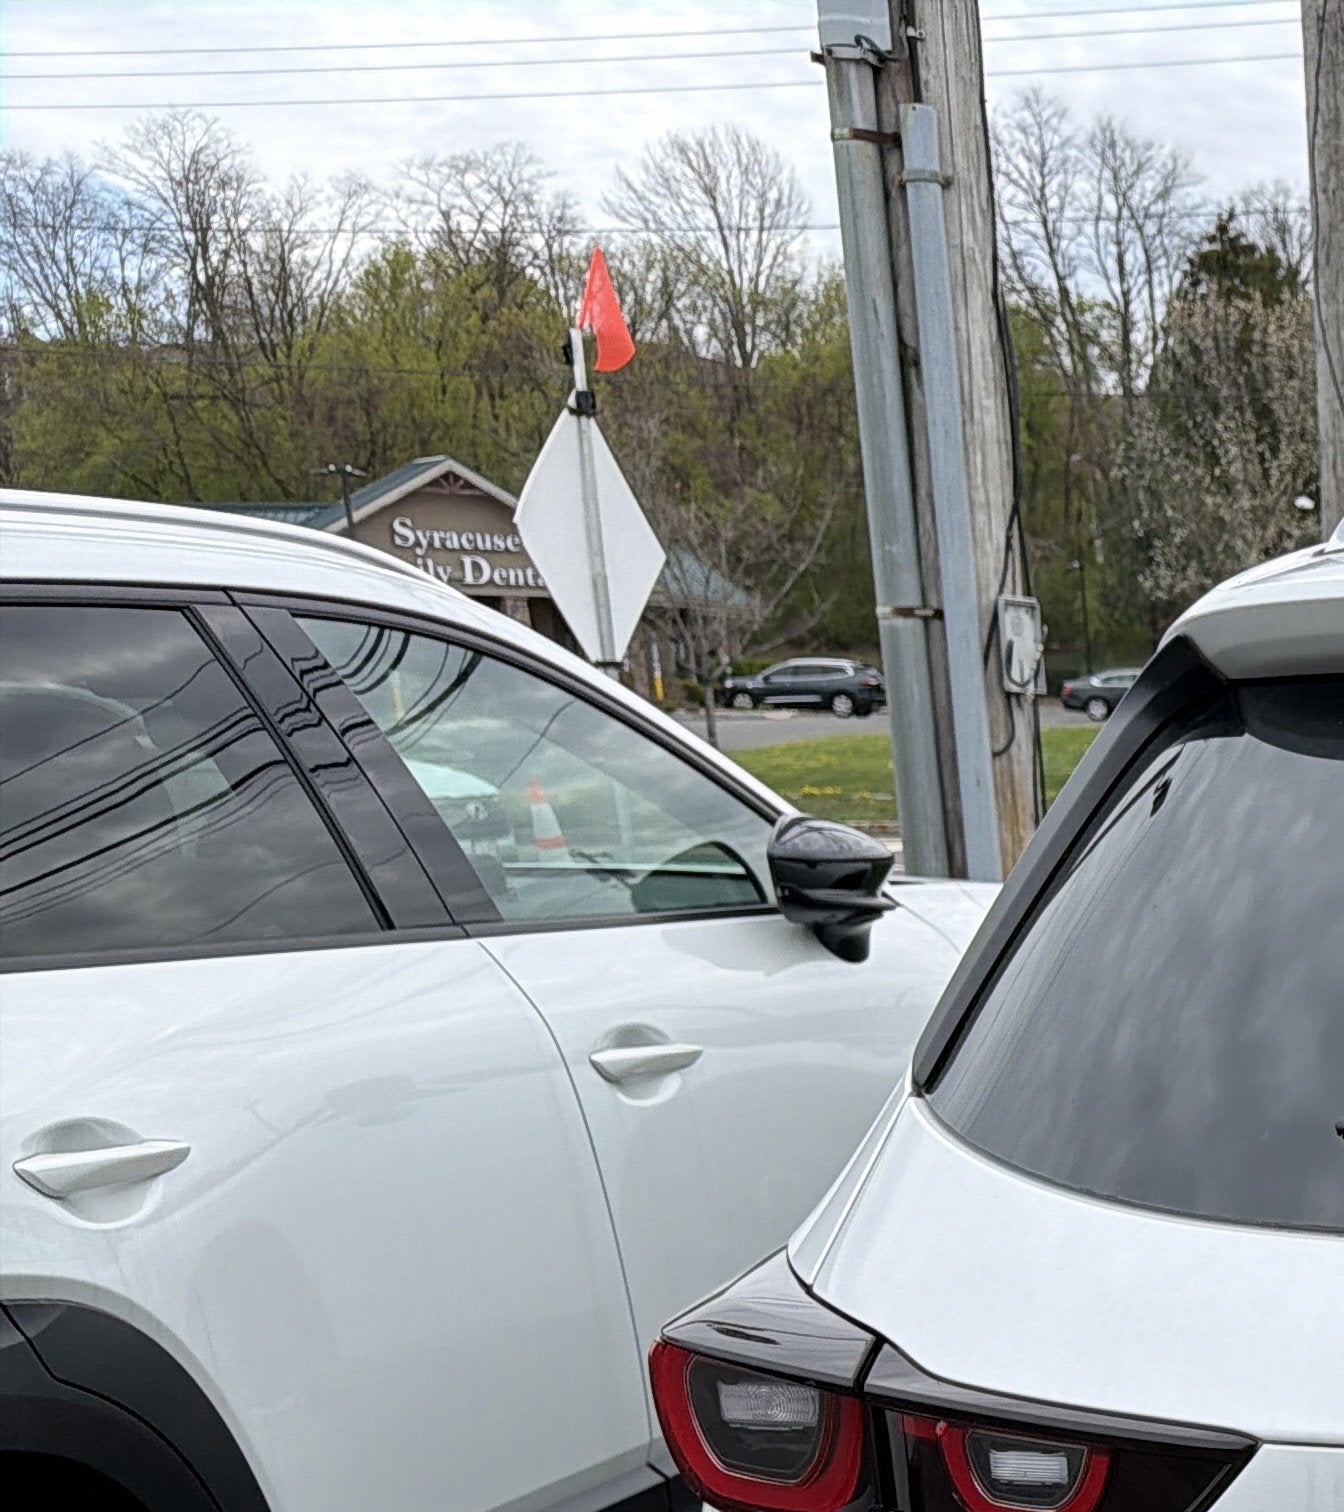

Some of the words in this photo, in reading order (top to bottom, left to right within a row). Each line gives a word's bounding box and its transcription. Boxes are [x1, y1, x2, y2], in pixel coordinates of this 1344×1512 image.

[392, 516, 521, 556] Syracuse
[415, 557, 452, 583] ily
[460, 554, 546, 587] Dent
